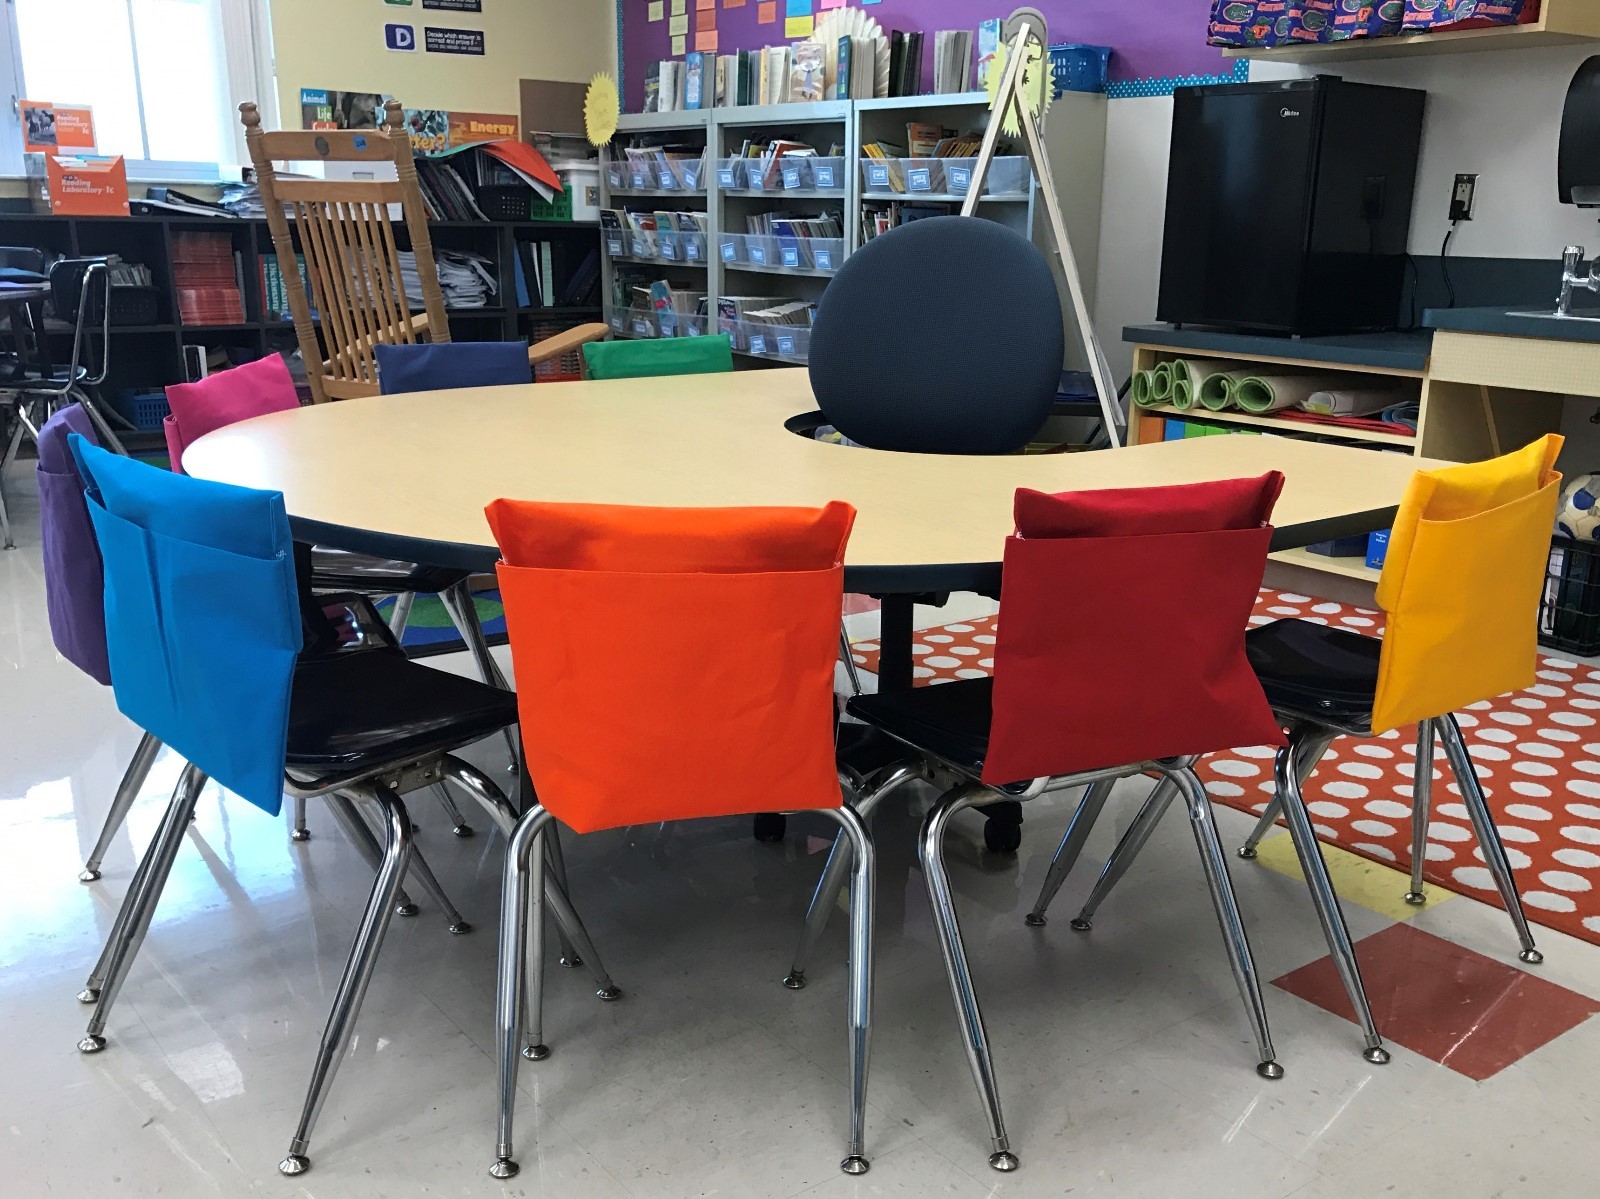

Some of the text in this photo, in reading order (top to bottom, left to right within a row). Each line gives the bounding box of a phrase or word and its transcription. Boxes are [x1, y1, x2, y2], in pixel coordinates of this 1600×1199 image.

[395, 27, 411, 46] D
[302, 92, 327, 104] Animal
[317, 106, 333, 122] Life
[469, 120, 515, 135] Energy
[61, 179, 91, 188] Reading
[62, 186, 103, 195] Laboratory
[269, 263, 280, 310] Dictionary
